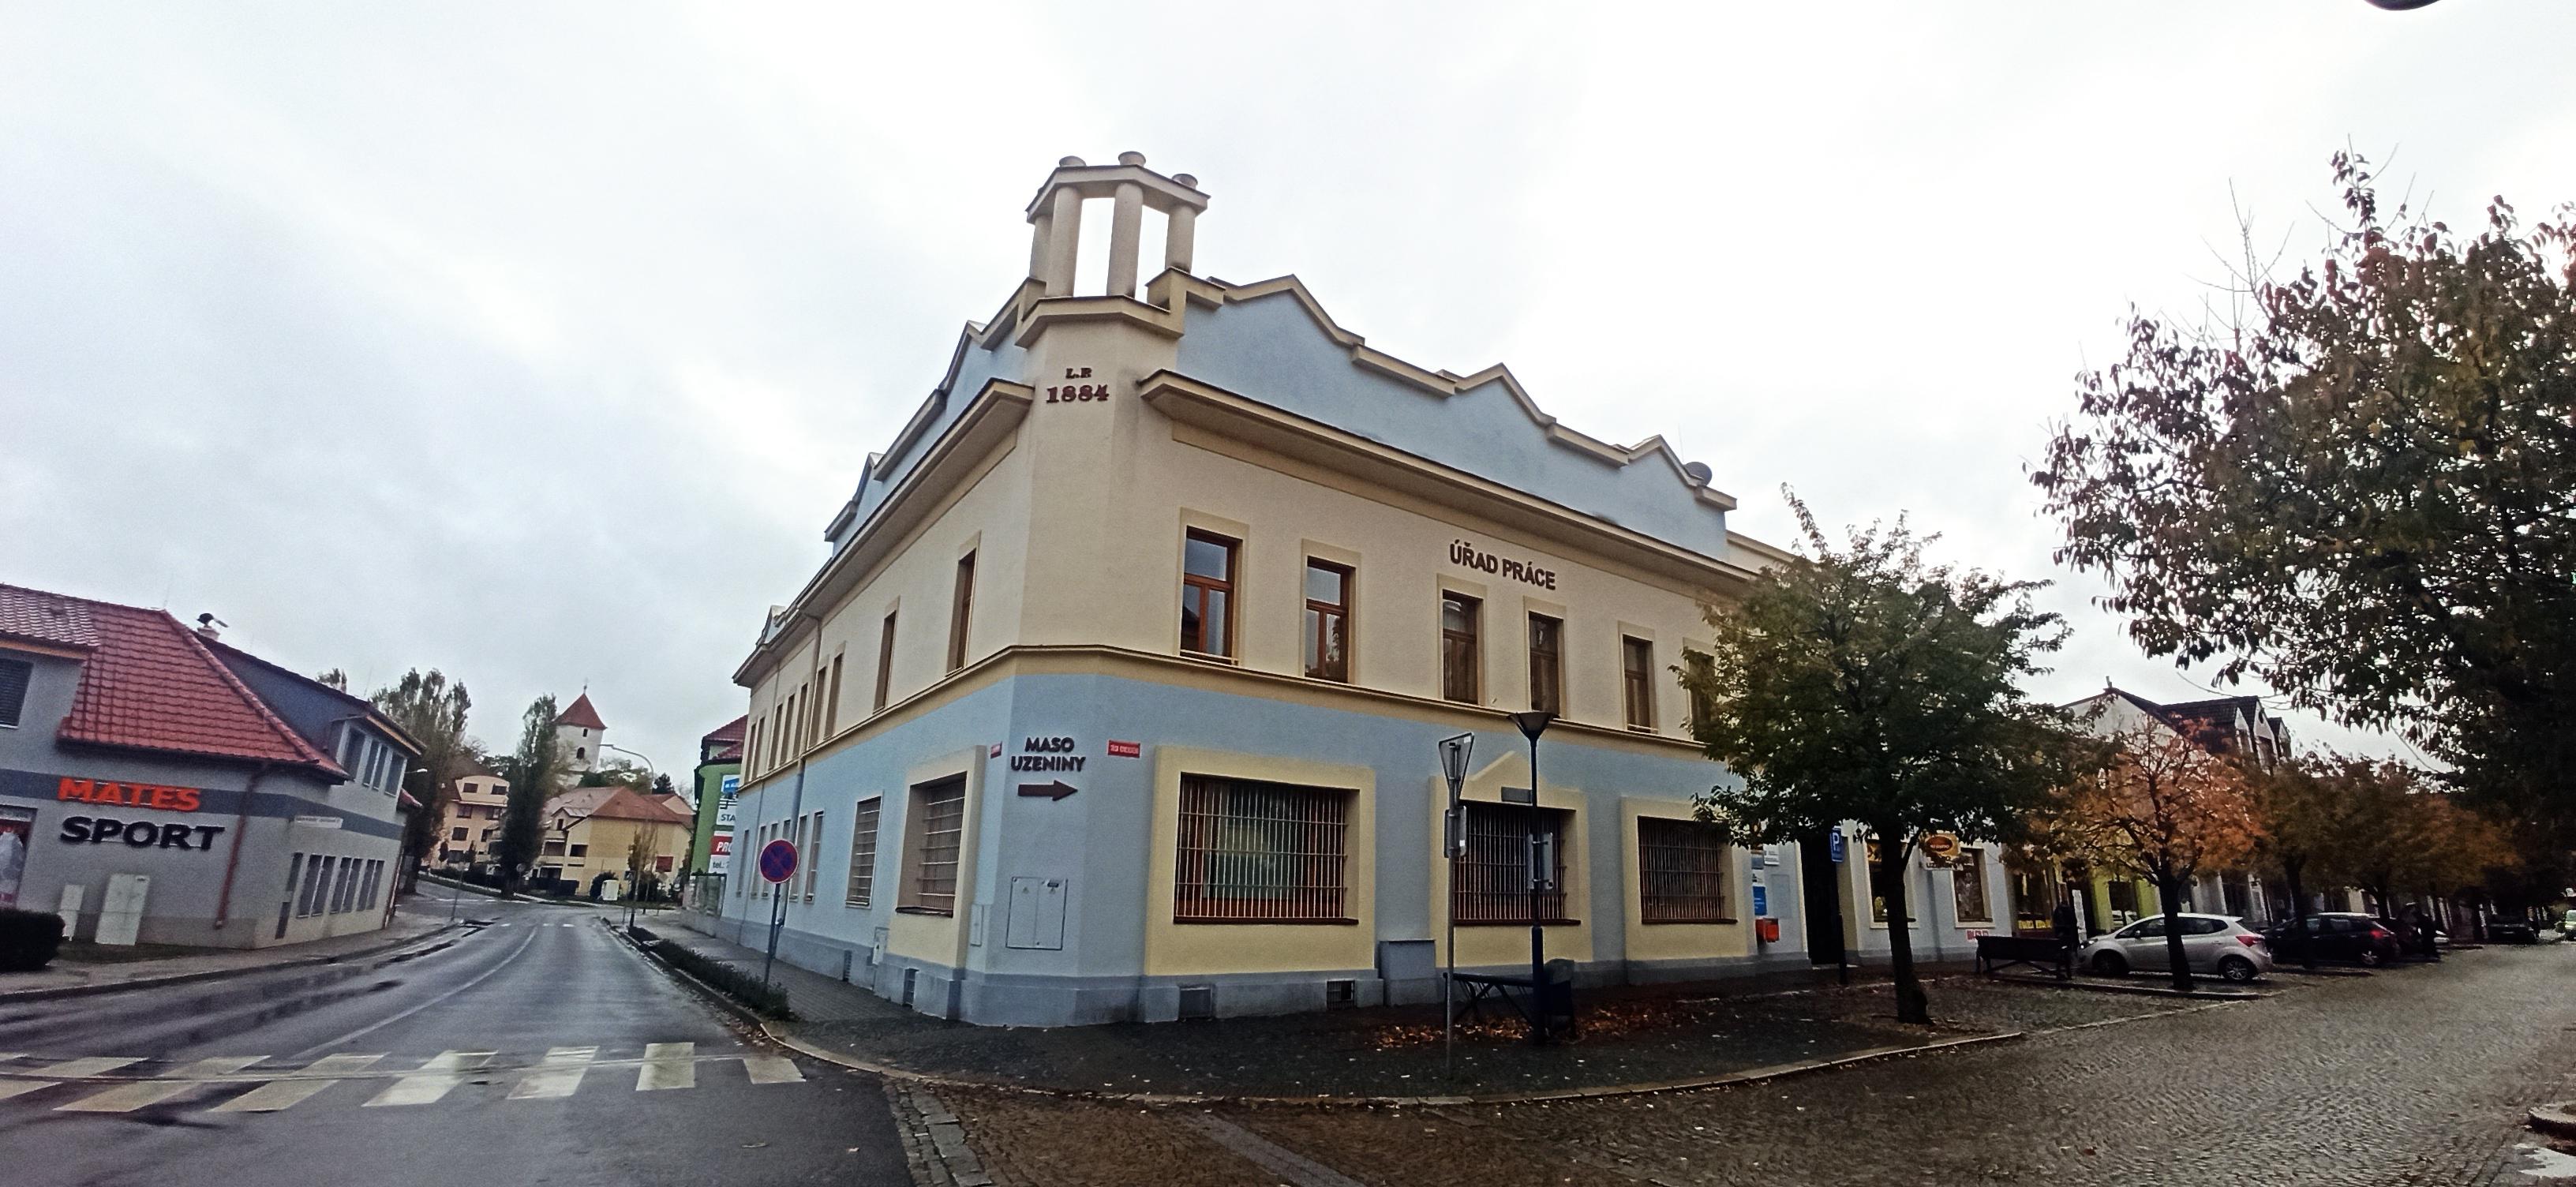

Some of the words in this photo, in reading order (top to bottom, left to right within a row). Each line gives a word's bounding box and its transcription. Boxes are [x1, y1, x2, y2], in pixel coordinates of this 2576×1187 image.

[1046, 384, 1110, 403] 1884
[1449, 538, 1499, 574] ÚŘAD
[1502, 558, 1556, 590] PRÁCE
[1024, 736, 1075, 752] MASO
[1011, 755, 1087, 772] UZENINY
[58, 776, 200, 811] MATES
[60, 815, 226, 850] SPORT
[1832, 832, 1840, 851] P
